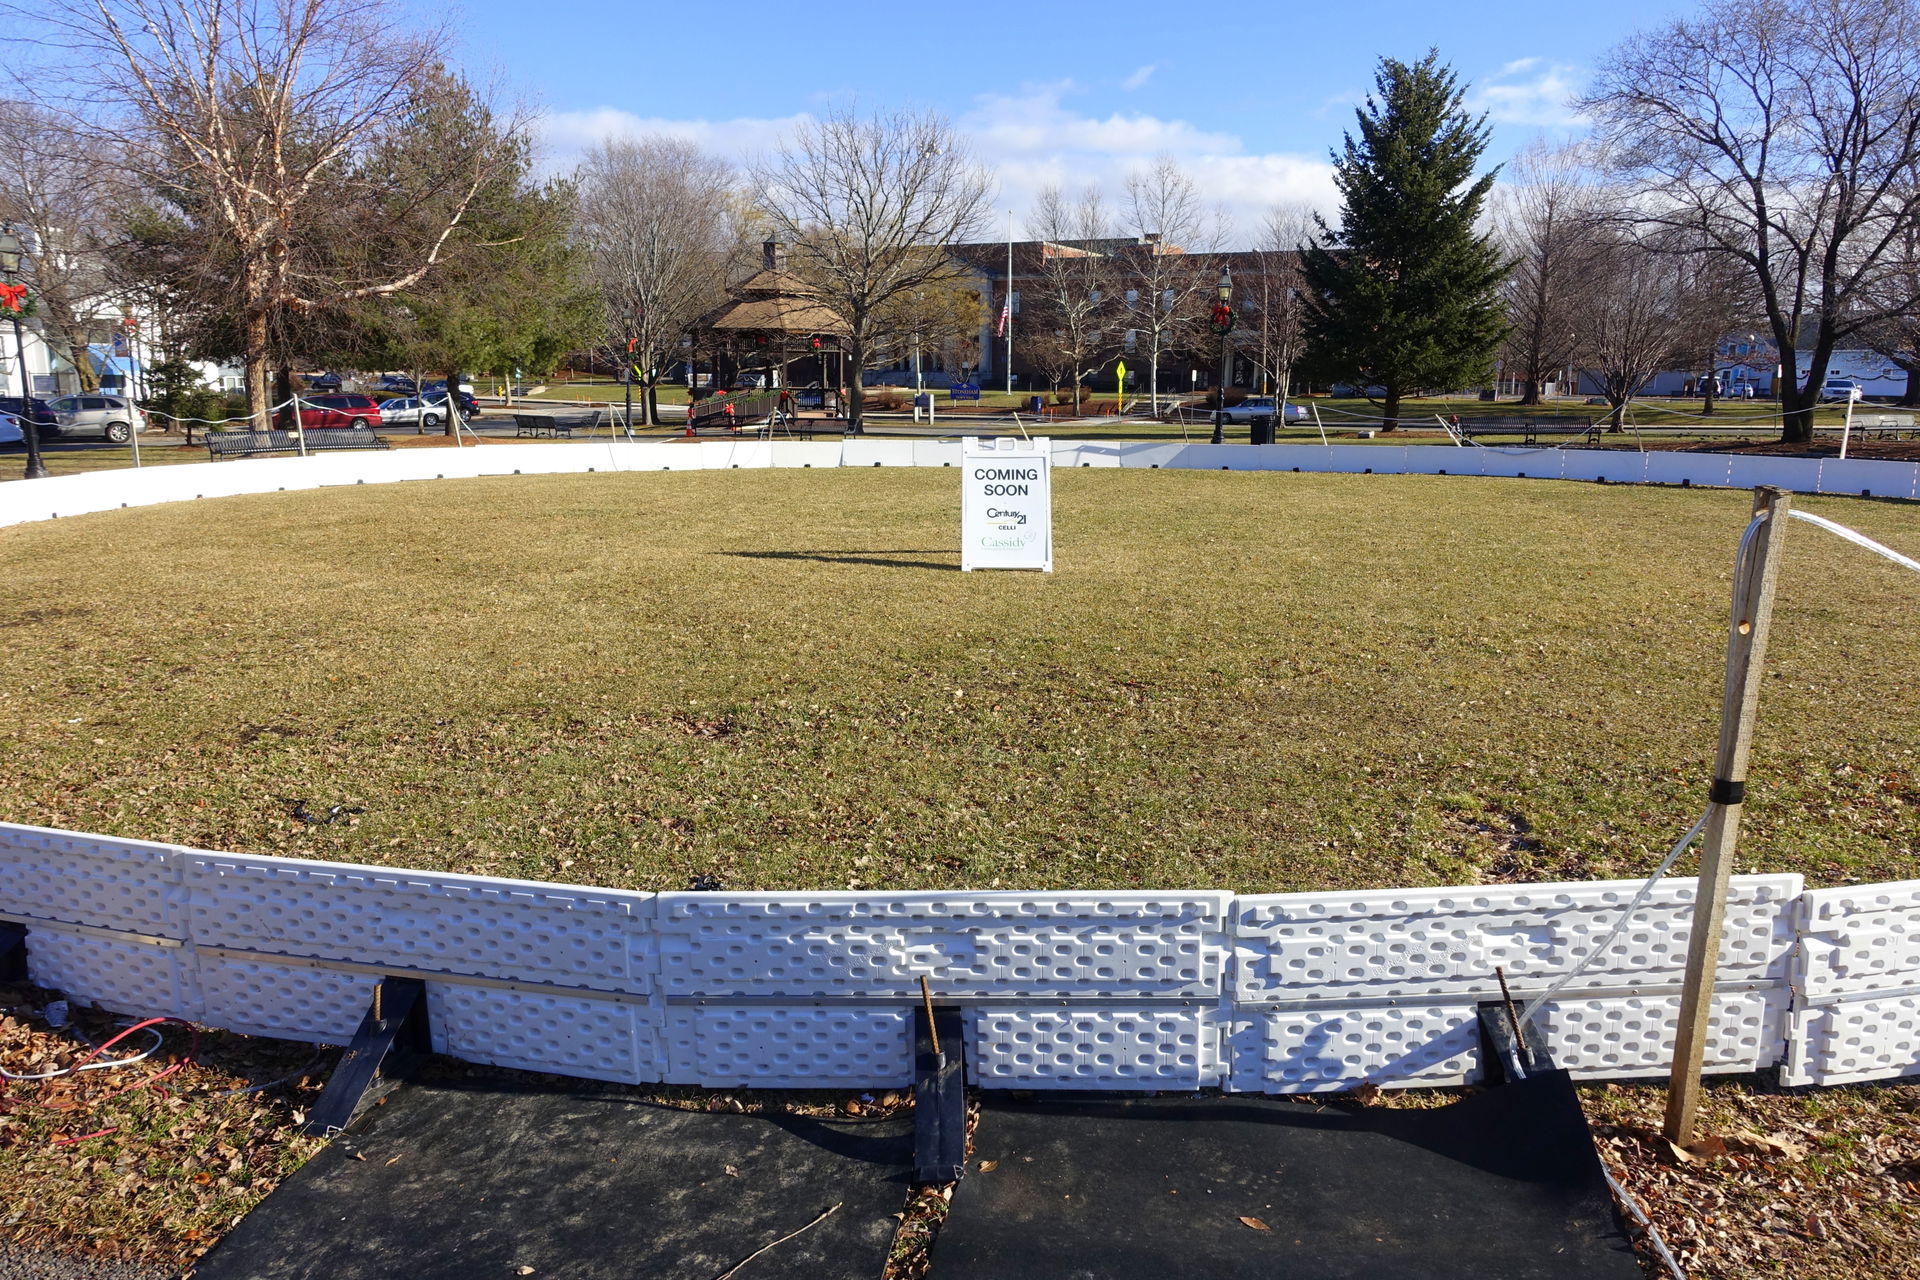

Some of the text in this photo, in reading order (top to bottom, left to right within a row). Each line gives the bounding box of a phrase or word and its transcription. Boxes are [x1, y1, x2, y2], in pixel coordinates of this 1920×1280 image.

[974, 468, 1038, 481] COMING
[984, 484, 1028, 496] SOON
[986, 507, 1027, 525] Century 21
[981, 536, 1026, 548] Cassidy
